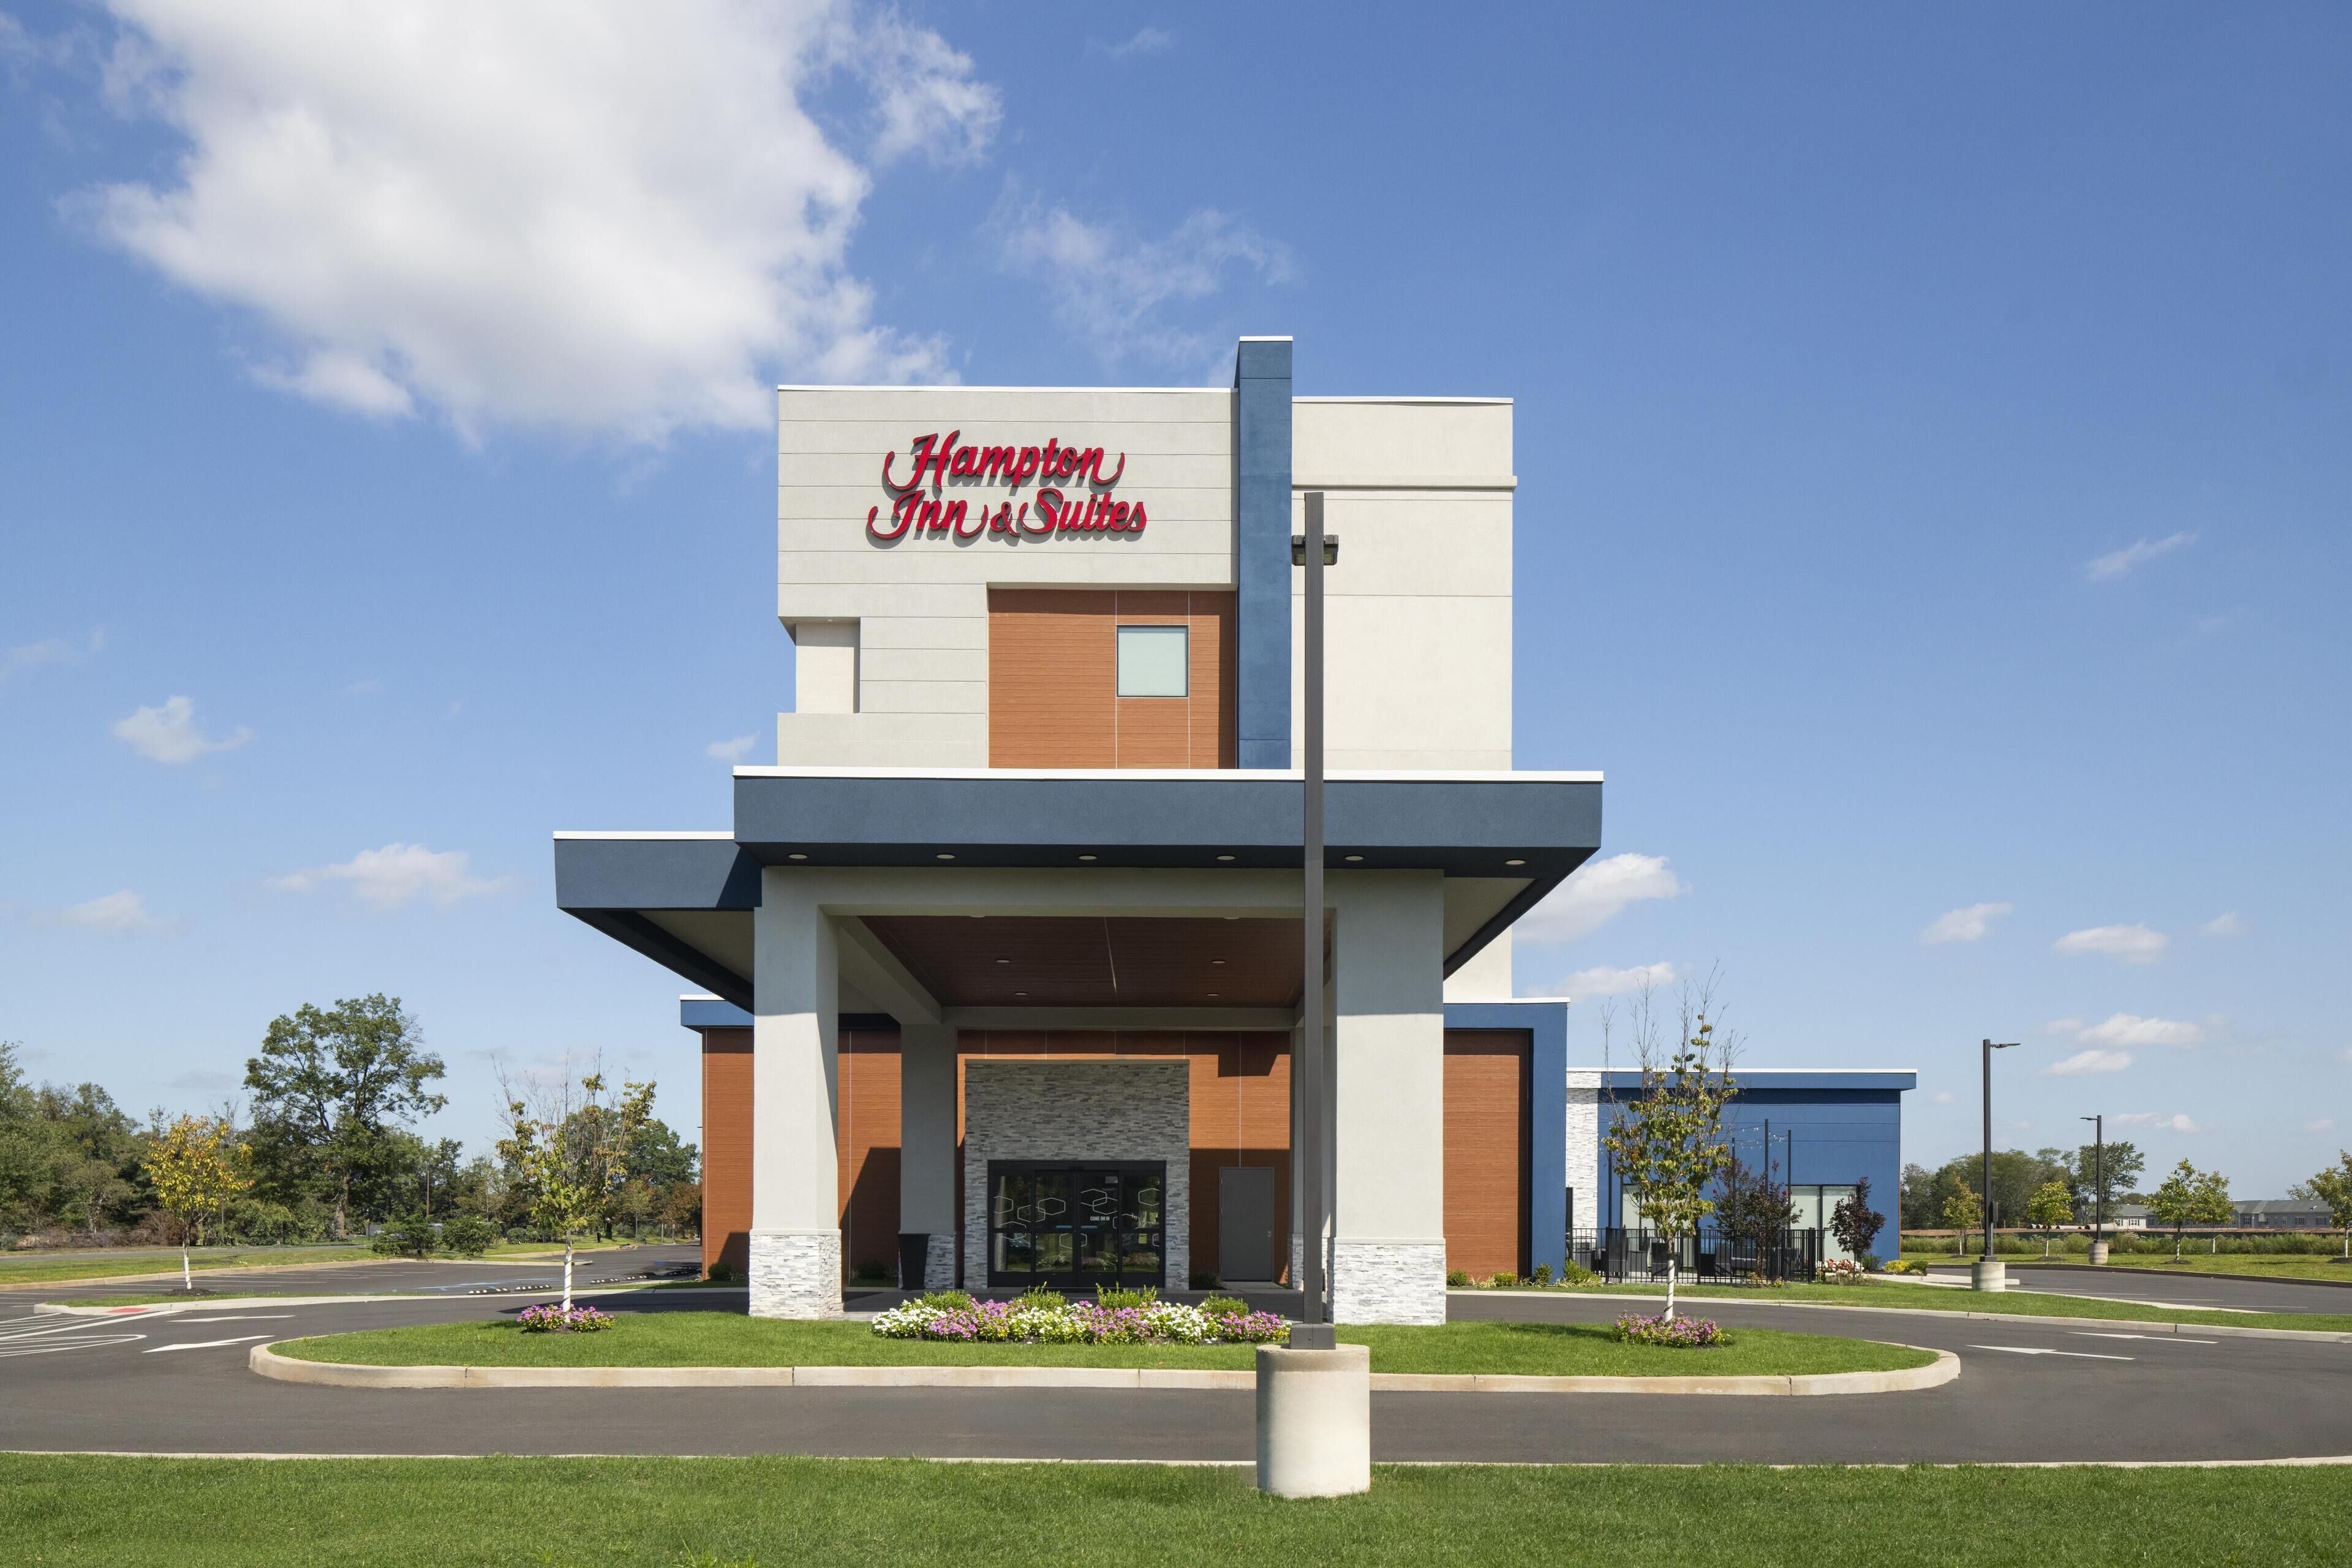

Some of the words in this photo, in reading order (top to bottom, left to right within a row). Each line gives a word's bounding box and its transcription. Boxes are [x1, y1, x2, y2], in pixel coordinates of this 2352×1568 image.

[884, 429, 1125, 491] Hampton
[867, 489, 989, 540] Inn
[990, 501, 1021, 537] &
[1018, 488, 1147, 533] Suites
